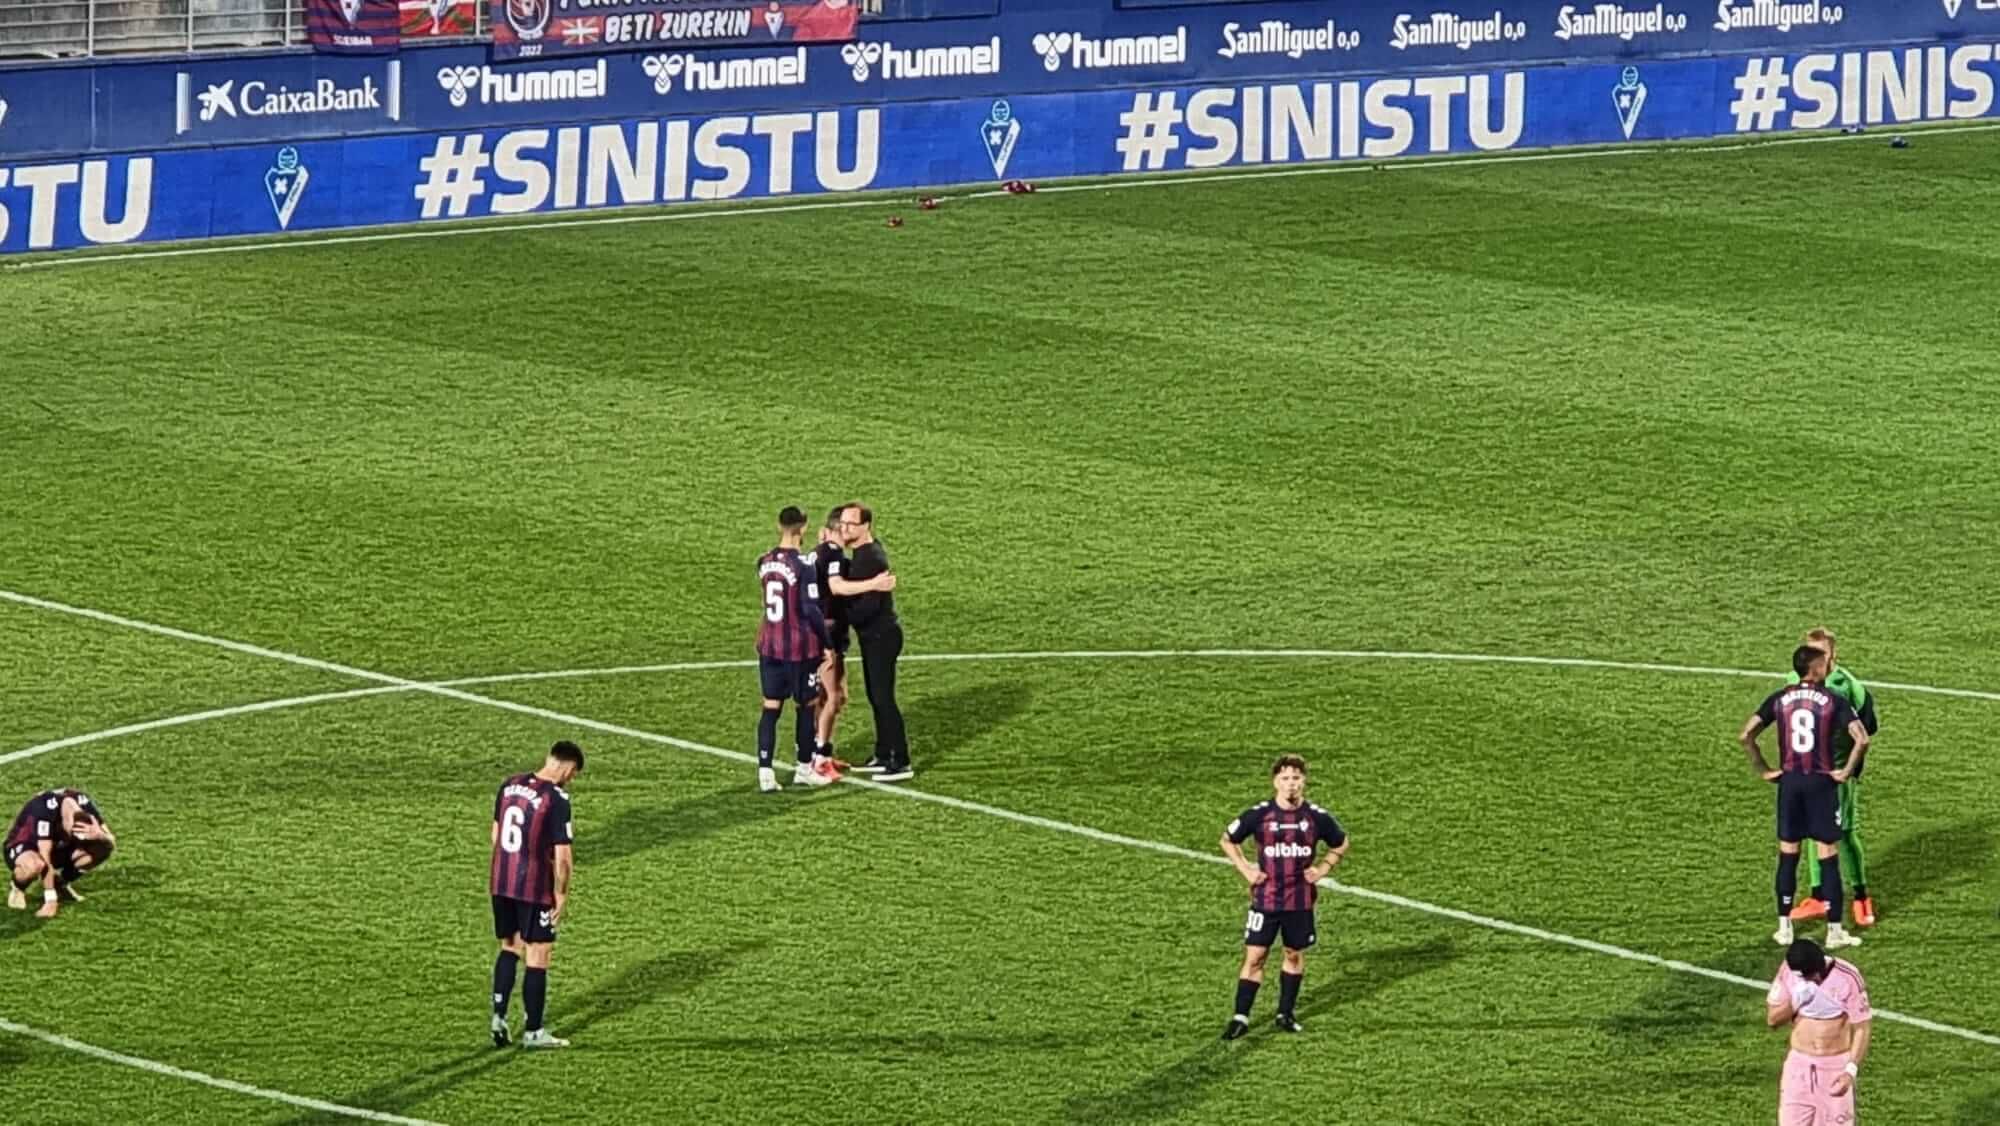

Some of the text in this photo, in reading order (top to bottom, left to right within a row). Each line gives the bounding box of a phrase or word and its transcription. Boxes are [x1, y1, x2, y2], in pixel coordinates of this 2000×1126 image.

[605, 10, 751, 43] BETI ZUREKIN
[1389, 11, 1526, 50] SanMiguel 0,0
[1554, 3, 1687, 41] SanMiguel 0,0
[1713, 0, 1843, 33] SanMiguel 0,0
[882, 36, 1000, 79] hummel
[1072, 26, 1186, 68] hummel
[1217, 20, 1360, 59] SanMiguel 0,0
[480, 58, 607, 103] hummel
[684, 46, 806, 91] hummel
[1730, 43, 2000, 131] #SINIS
[240, 76, 380, 116] CaixaBank
[1115, 71, 1526, 171] #SINISTU
[413, 107, 881, 219] #SINISTU
[766, 581, 784, 622] 5
[1791, 708, 1815, 753] 8
[501, 805, 525, 853] 6
